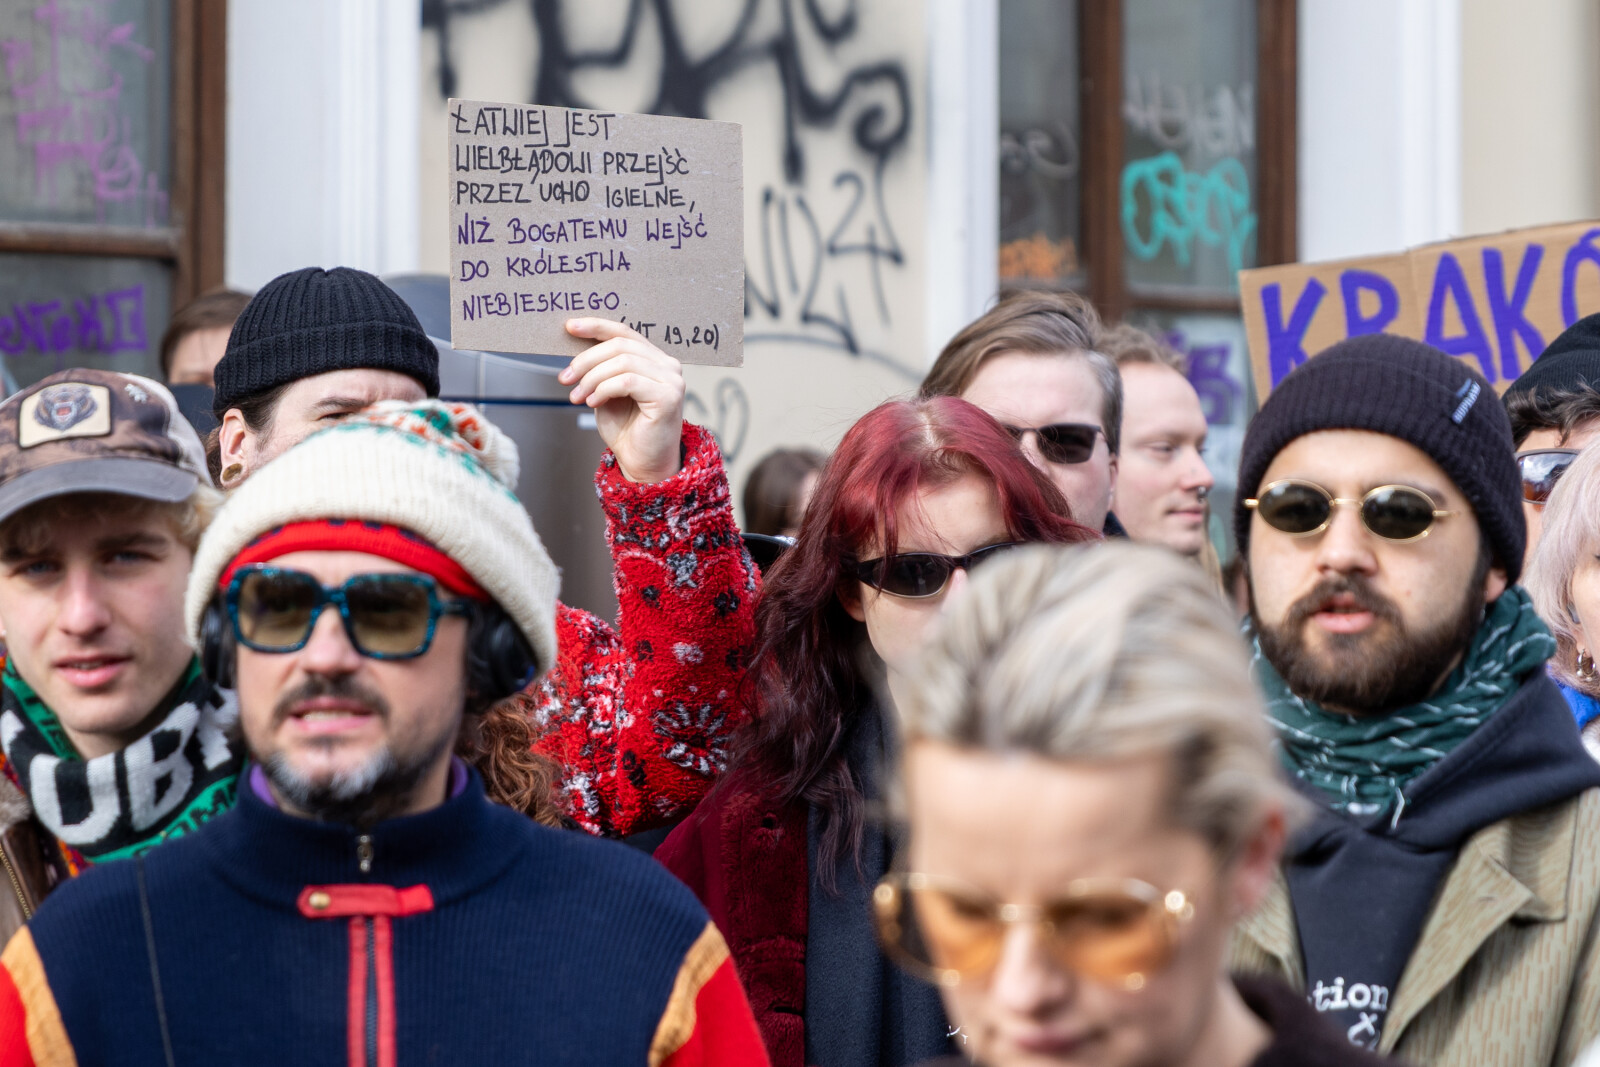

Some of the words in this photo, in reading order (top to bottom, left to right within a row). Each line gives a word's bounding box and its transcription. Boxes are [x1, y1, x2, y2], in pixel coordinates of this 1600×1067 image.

[451, 104, 549, 147] ŁATWIEJ
[553, 111, 616, 147] JEST
[456, 144, 592, 185] WIELBŁĄDOWI
[603, 146, 690, 187] PRZEJŚĆ
[456, 181, 532, 205] PRZEZ
[539, 180, 590, 203] UCHO
[606, 185, 696, 213] IGIELNE,
[457, 212, 495, 245] NIŻ
[507, 217, 628, 245] BOGATEMU
[646, 212, 708, 250] WEJŚĆ
[459, 260, 490, 282] DO
[507, 248, 631, 278] KRÓLESTWA
[664, 323, 719, 353] 19,20)
[1307, 976, 1389, 1012] tion
